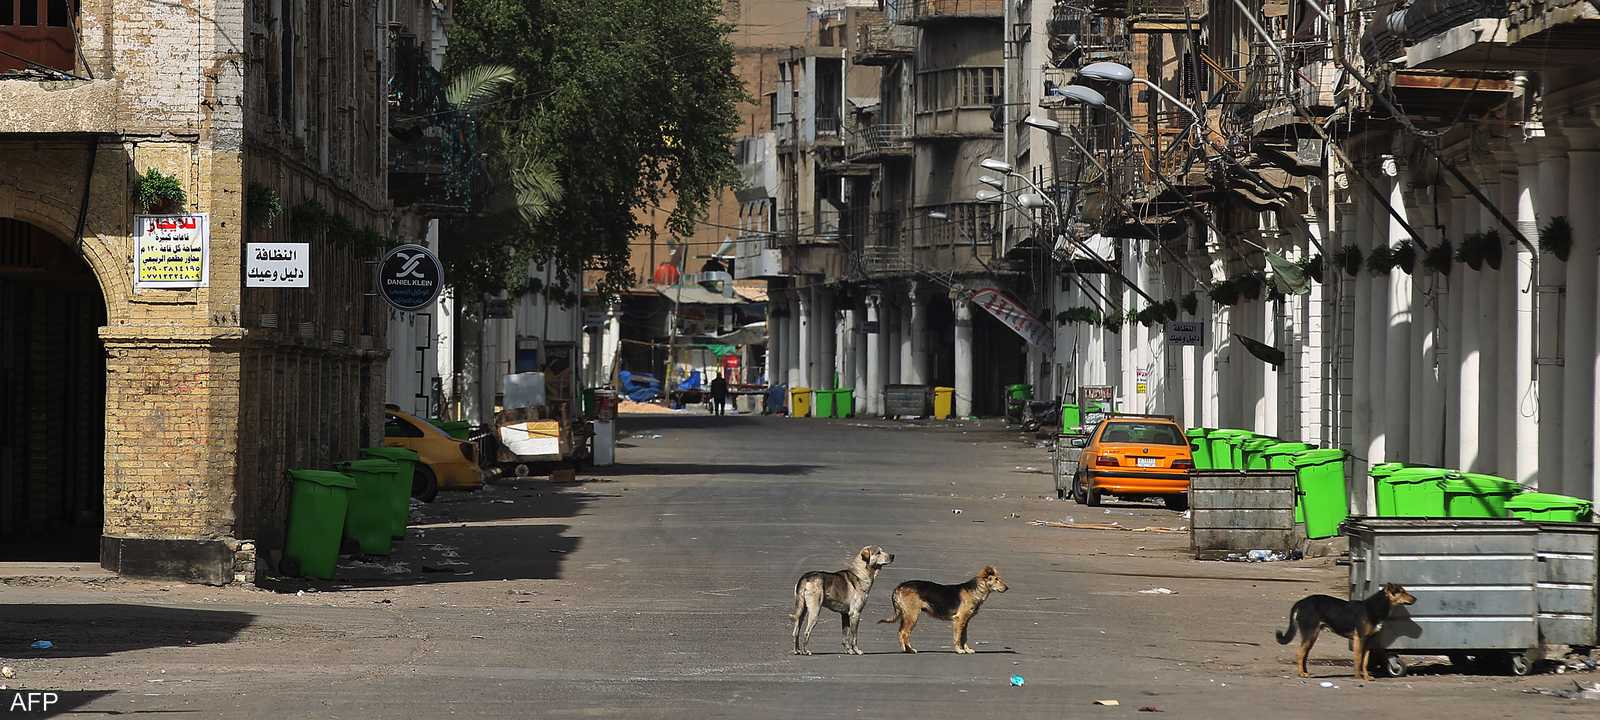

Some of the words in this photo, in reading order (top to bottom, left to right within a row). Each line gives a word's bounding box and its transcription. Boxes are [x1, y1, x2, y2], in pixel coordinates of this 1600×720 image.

[155, 232, 172, 243] كبيرة
[173, 233, 189, 241] قاعات
[172, 244, 181, 254] كل
[182, 244, 201, 252] مساحة
[255, 247, 297, 261] النظافة
[248, 267, 278, 282] وعيك
[280, 267, 304, 282] دليل
